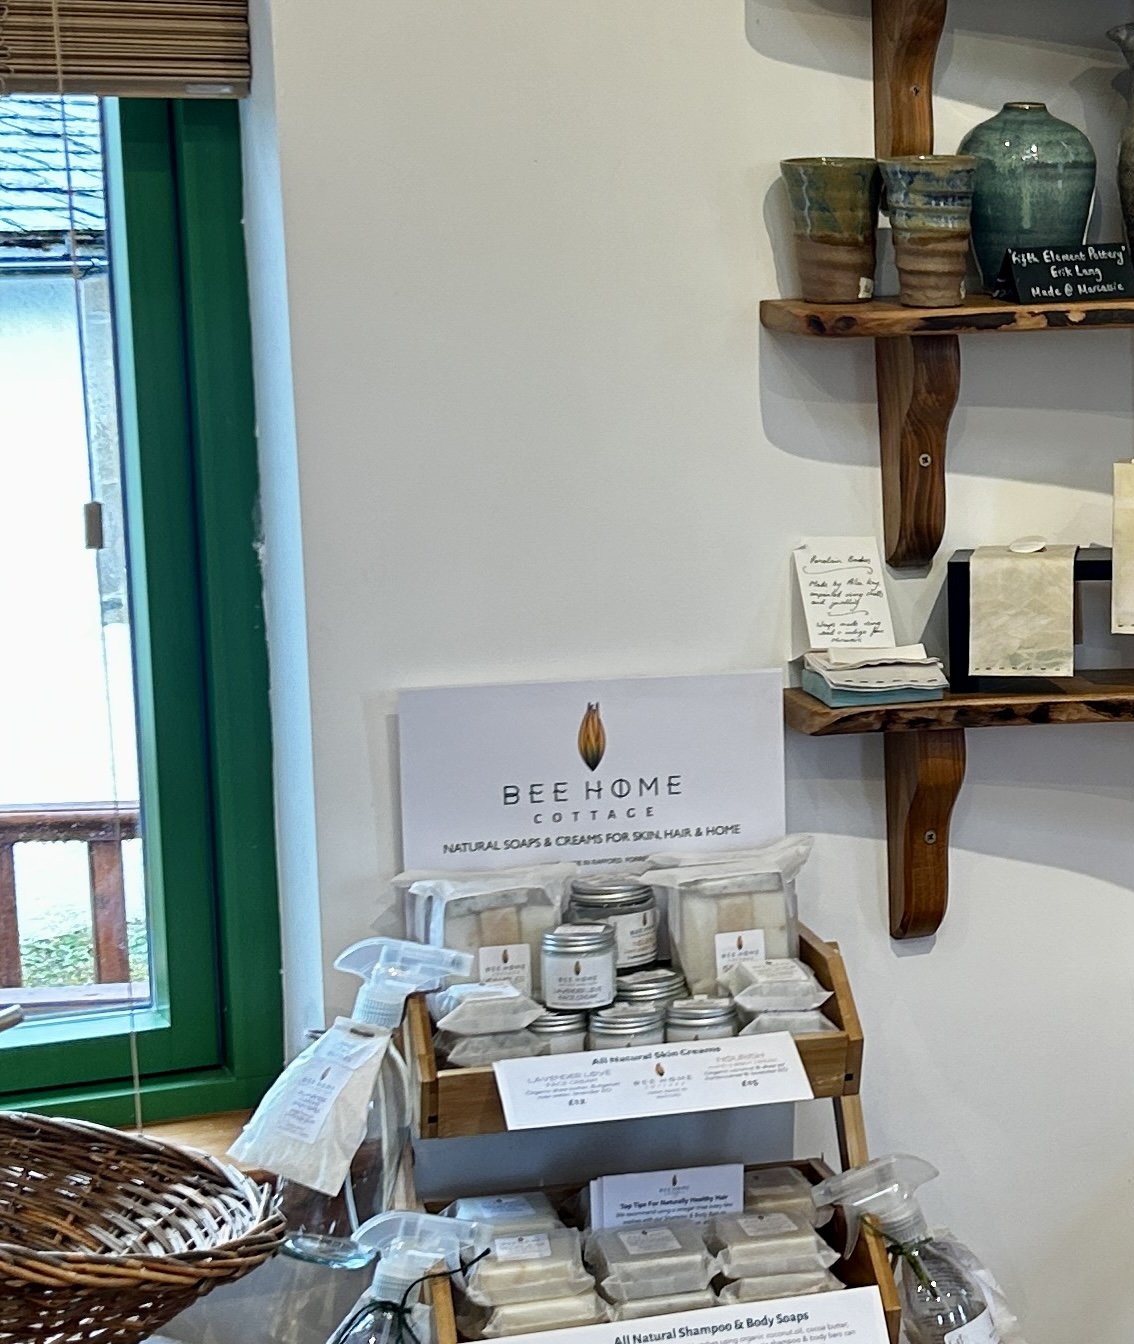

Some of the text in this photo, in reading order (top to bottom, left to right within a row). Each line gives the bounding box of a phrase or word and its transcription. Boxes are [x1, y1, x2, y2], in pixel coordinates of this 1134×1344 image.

[1043, 250, 1086, 263] Element
[1051, 265, 1102, 282] Erik Lang
[1031, 286, 1062, 297] Made
[1064, 283, 1073, 296] @
[503, 775, 682, 805] BEE HOME
[533, 806, 654, 824] COTTAGE
[443, 840, 500, 854] NATURAL
[503, 837, 541, 850] SOAPS
[544, 837, 552, 847] &
[555, 833, 602, 847] CREAMS
[606, 832, 630, 844] FOR
[664, 827, 691, 840] HAIR
[695, 827, 703, 837] &
[706, 823, 741, 836] HOME
[633, 1328, 676, 1344] Natural
[679, 1323, 732, 1338] Shampoo
[735, 1320, 744, 1329] &
[746, 1315, 774, 1328] Body
[776, 1312, 809, 1324] Soaps
